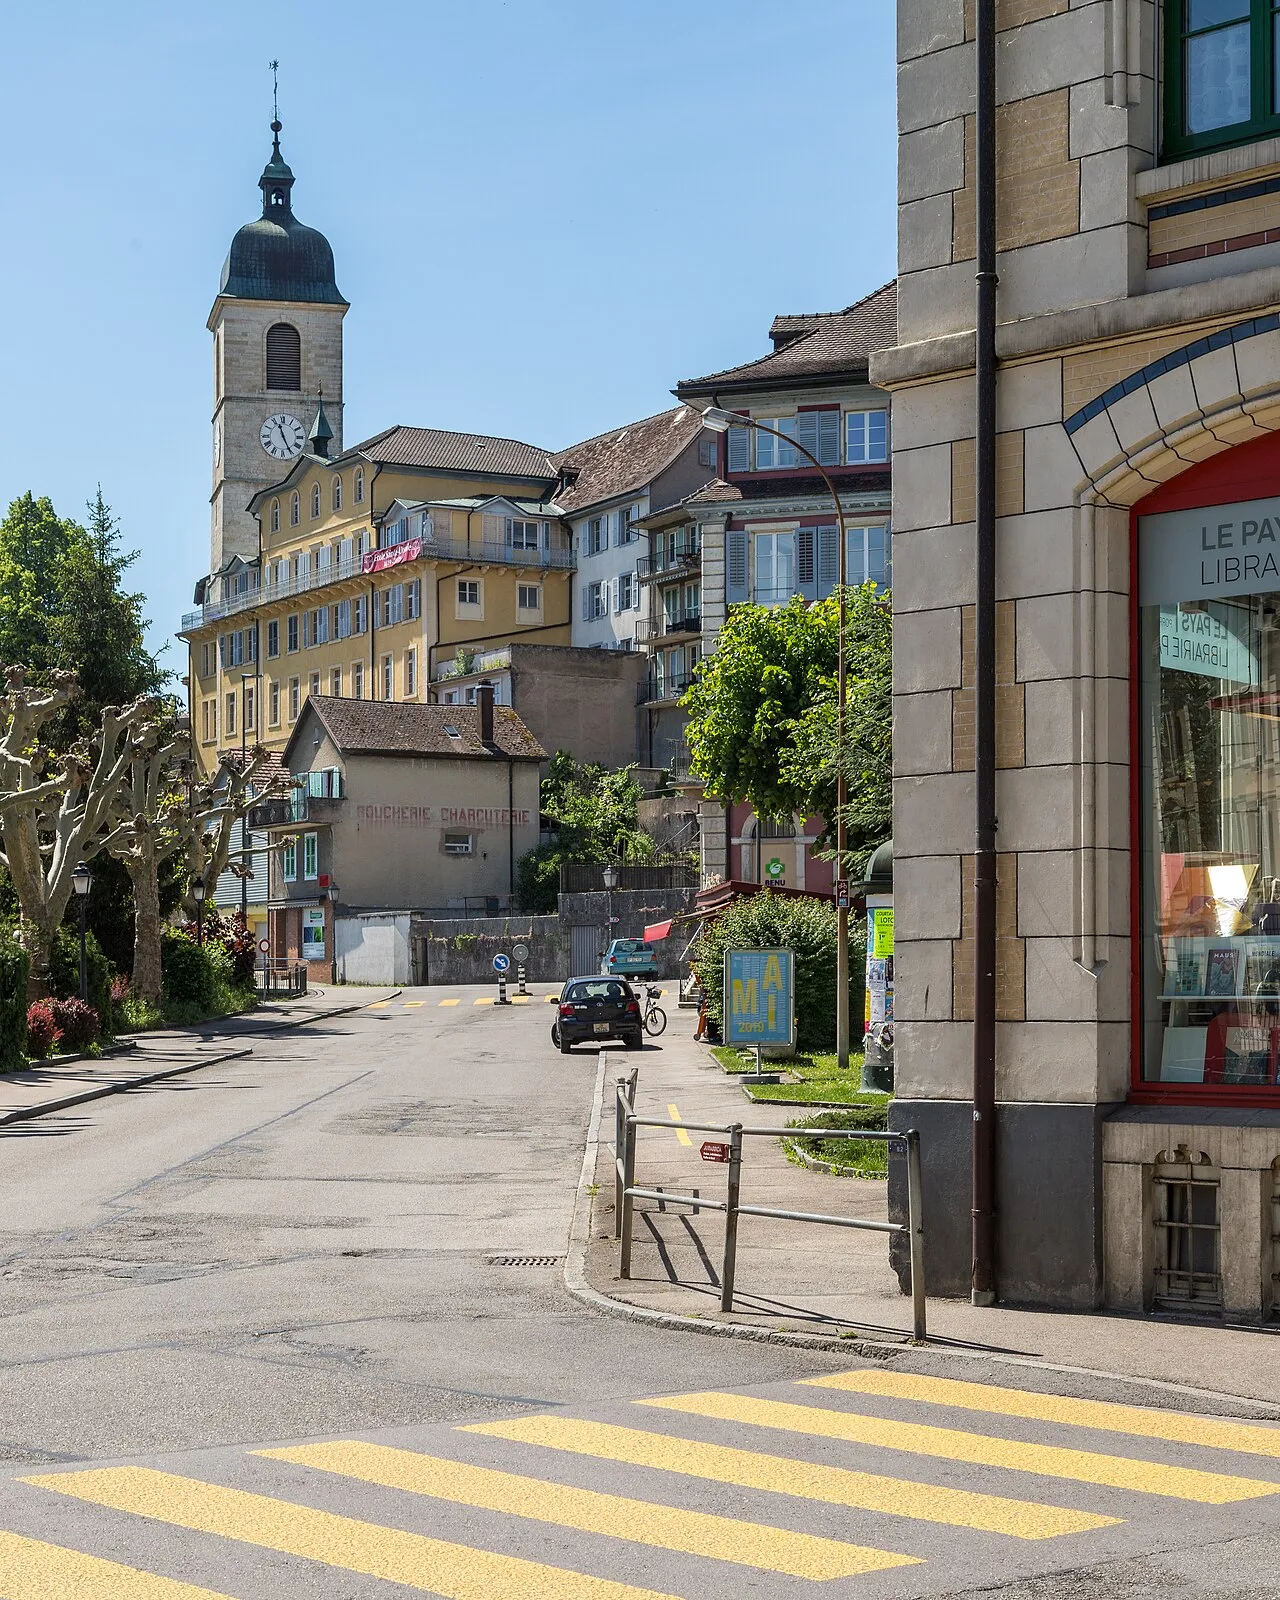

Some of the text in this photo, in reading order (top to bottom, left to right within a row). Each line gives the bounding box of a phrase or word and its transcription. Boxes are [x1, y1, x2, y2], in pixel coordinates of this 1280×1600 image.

[1202, 523, 1233, 551] LE
[1201, 553, 1279, 586] LIBRA
[356, 804, 530, 823] BOUCHERIE CHARCUTERIE
[765, 879, 786, 887] BENU
[738, 1022, 765, 1033] 2019
